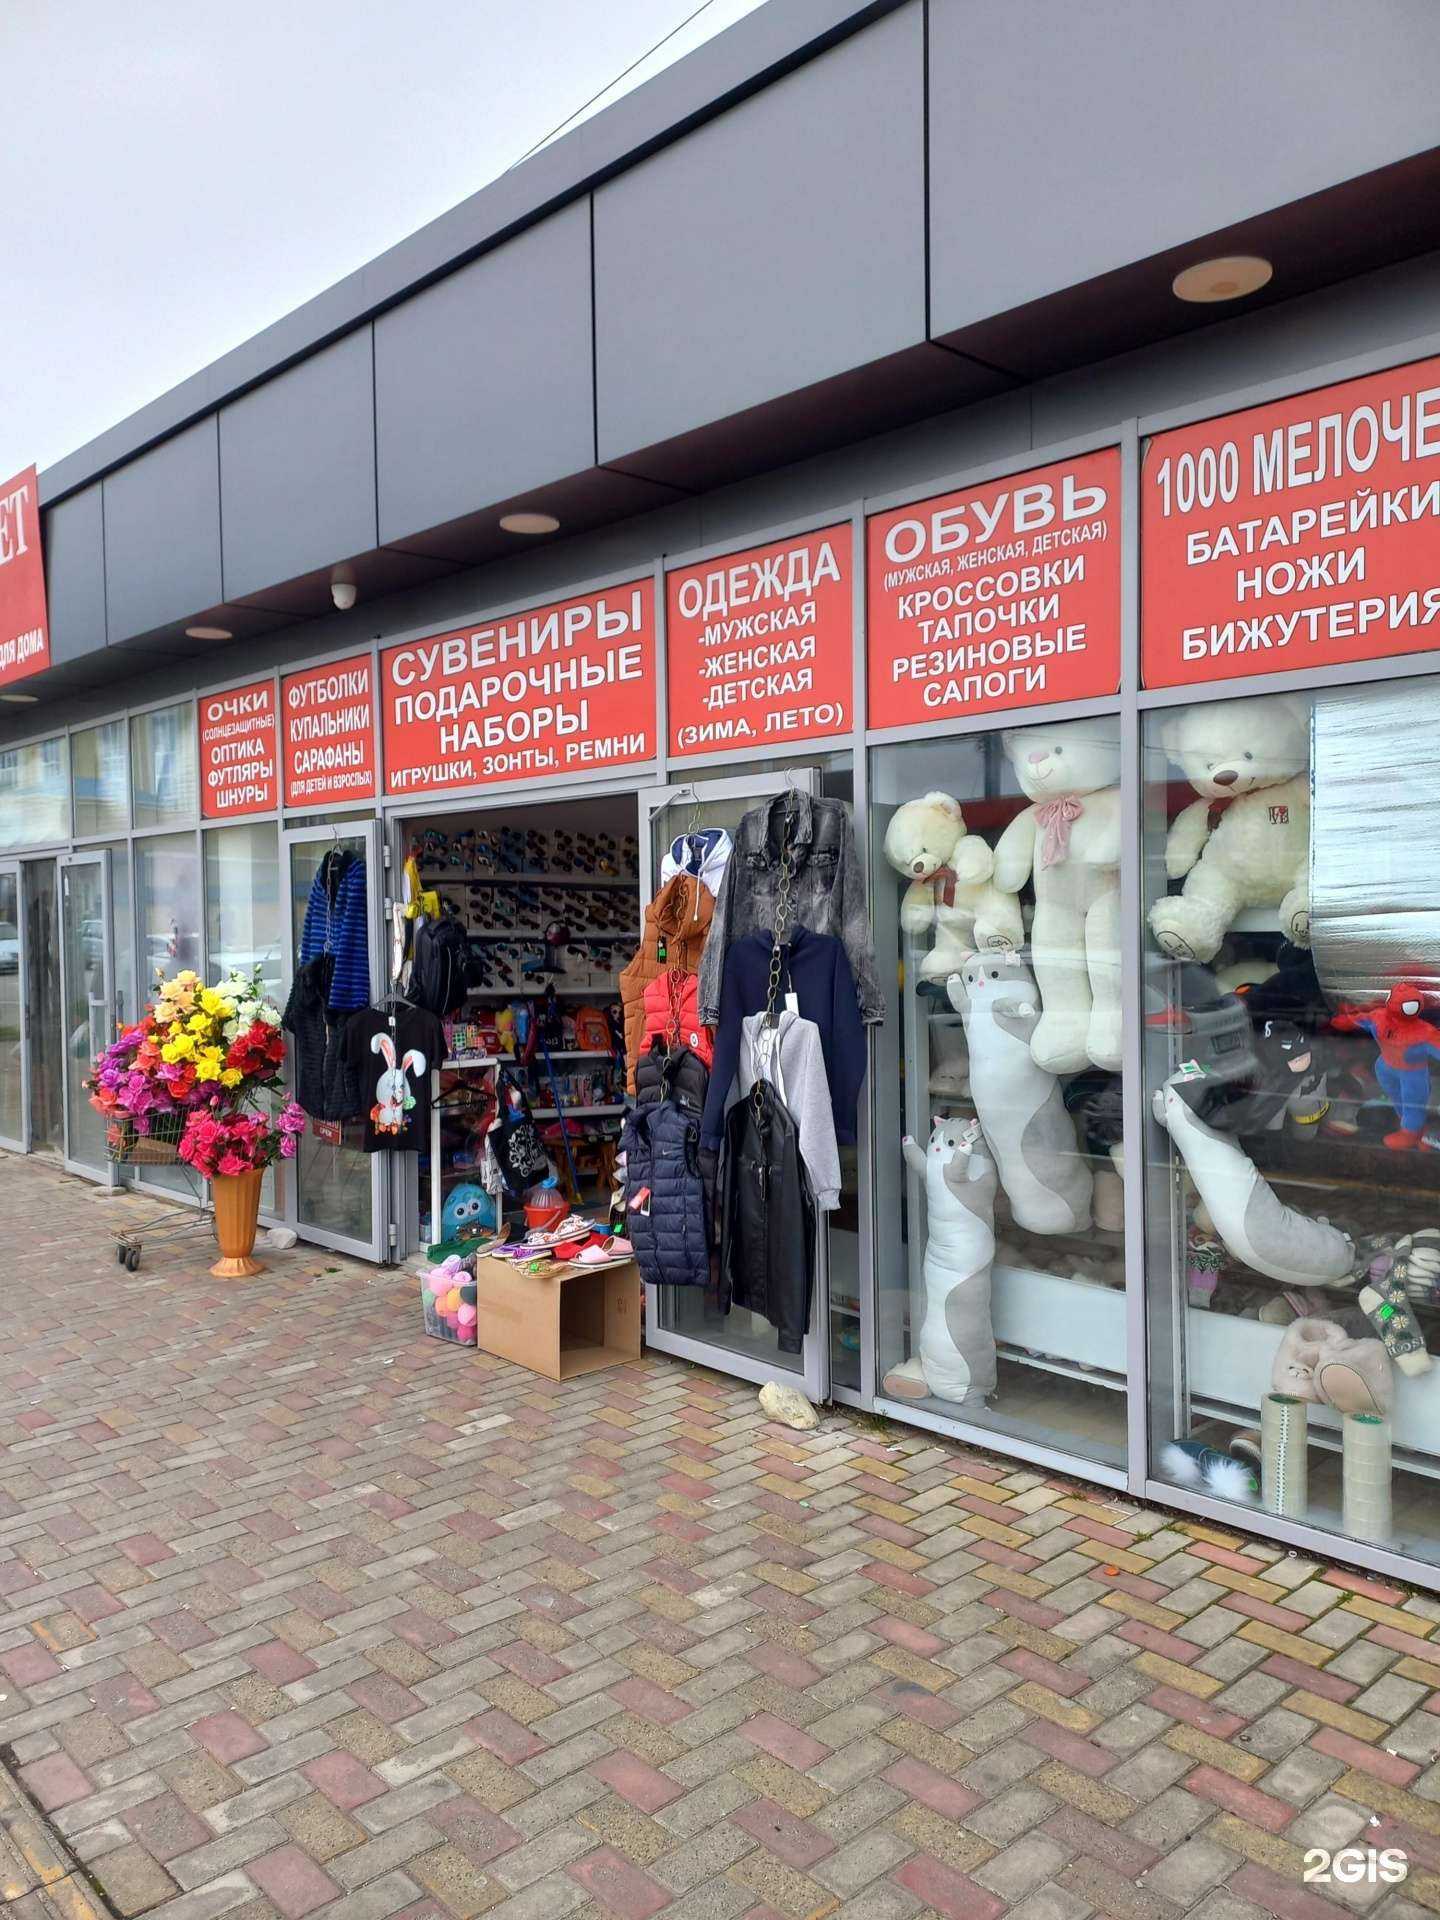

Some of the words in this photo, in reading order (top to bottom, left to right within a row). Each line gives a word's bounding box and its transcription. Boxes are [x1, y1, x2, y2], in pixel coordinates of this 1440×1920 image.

[1156, 442, 1239, 516] 1000
[1253, 387, 1440, 496] МЕЛОЧЕ
[884, 475, 1107, 563] ОБУВЬ
[1186, 480, 1440, 566] БАТАРЕЙКИ
[884, 558, 954, 592] (МУЖСКАЯ,
[957, 540, 1030, 573] ЖЕНСКАЯ,
[1031, 520, 1108, 556] ДЕТСКАЯ)
[1236, 547, 1366, 602] НОЖИ
[678, 542, 841, 621] ОДЕЖДА
[898, 555, 1085, 619] КРОССОВКИ
[391, 590, 642, 686] СУВЕНИРЫ
[698, 601, 817, 647] -МУЖСКАЯ
[917, 593, 1060, 645] ТАПОЧКИ
[1182, 588, 1440, 661] БИЖУТЕРИЯ
[17, 627, 44, 664] ДОМА
[699, 635, 816, 679] -ЖЕНСКАЯ
[892, 623, 1087, 682] РЕЗИНОВЫЕ
[207, 690, 268, 722] ОЧКИ
[288, 668, 368, 709] ФУТБОЛКИ
[394, 644, 643, 725] ПОДАРОЧНЫЕ
[702, 668, 813, 711] -ДЕТСКАЯ
[923, 664, 1047, 706] САПОГИ
[202, 713, 275, 744] (СОЛНЦЕЗАЩИТНЫЕ)
[290, 703, 370, 742] КУПАЛЬНИКИ
[440, 699, 589, 755] НАБОРЫ
[677, 718, 757, 749] (ЗИМА,
[764, 702, 844, 732] ЛЕТО)
[207, 759, 273, 787] ФУТЛЯРЫ
[211, 737, 264, 764] ОПТИКА
[294, 740, 364, 774] САРАФАНЫ
[390, 760, 477, 788] ИГРУШКИ,
[482, 746, 559, 775] ЗОНТЫ,
[566, 732, 645, 763] РЕМНИ
[216, 783, 268, 808] ШНУРЫ
[290, 779, 305, 798] (ДЛЯ
[305, 777, 327, 794] ДЕТЕЙ
[333, 770, 372, 790] ВЗРОСЛЫХ)
